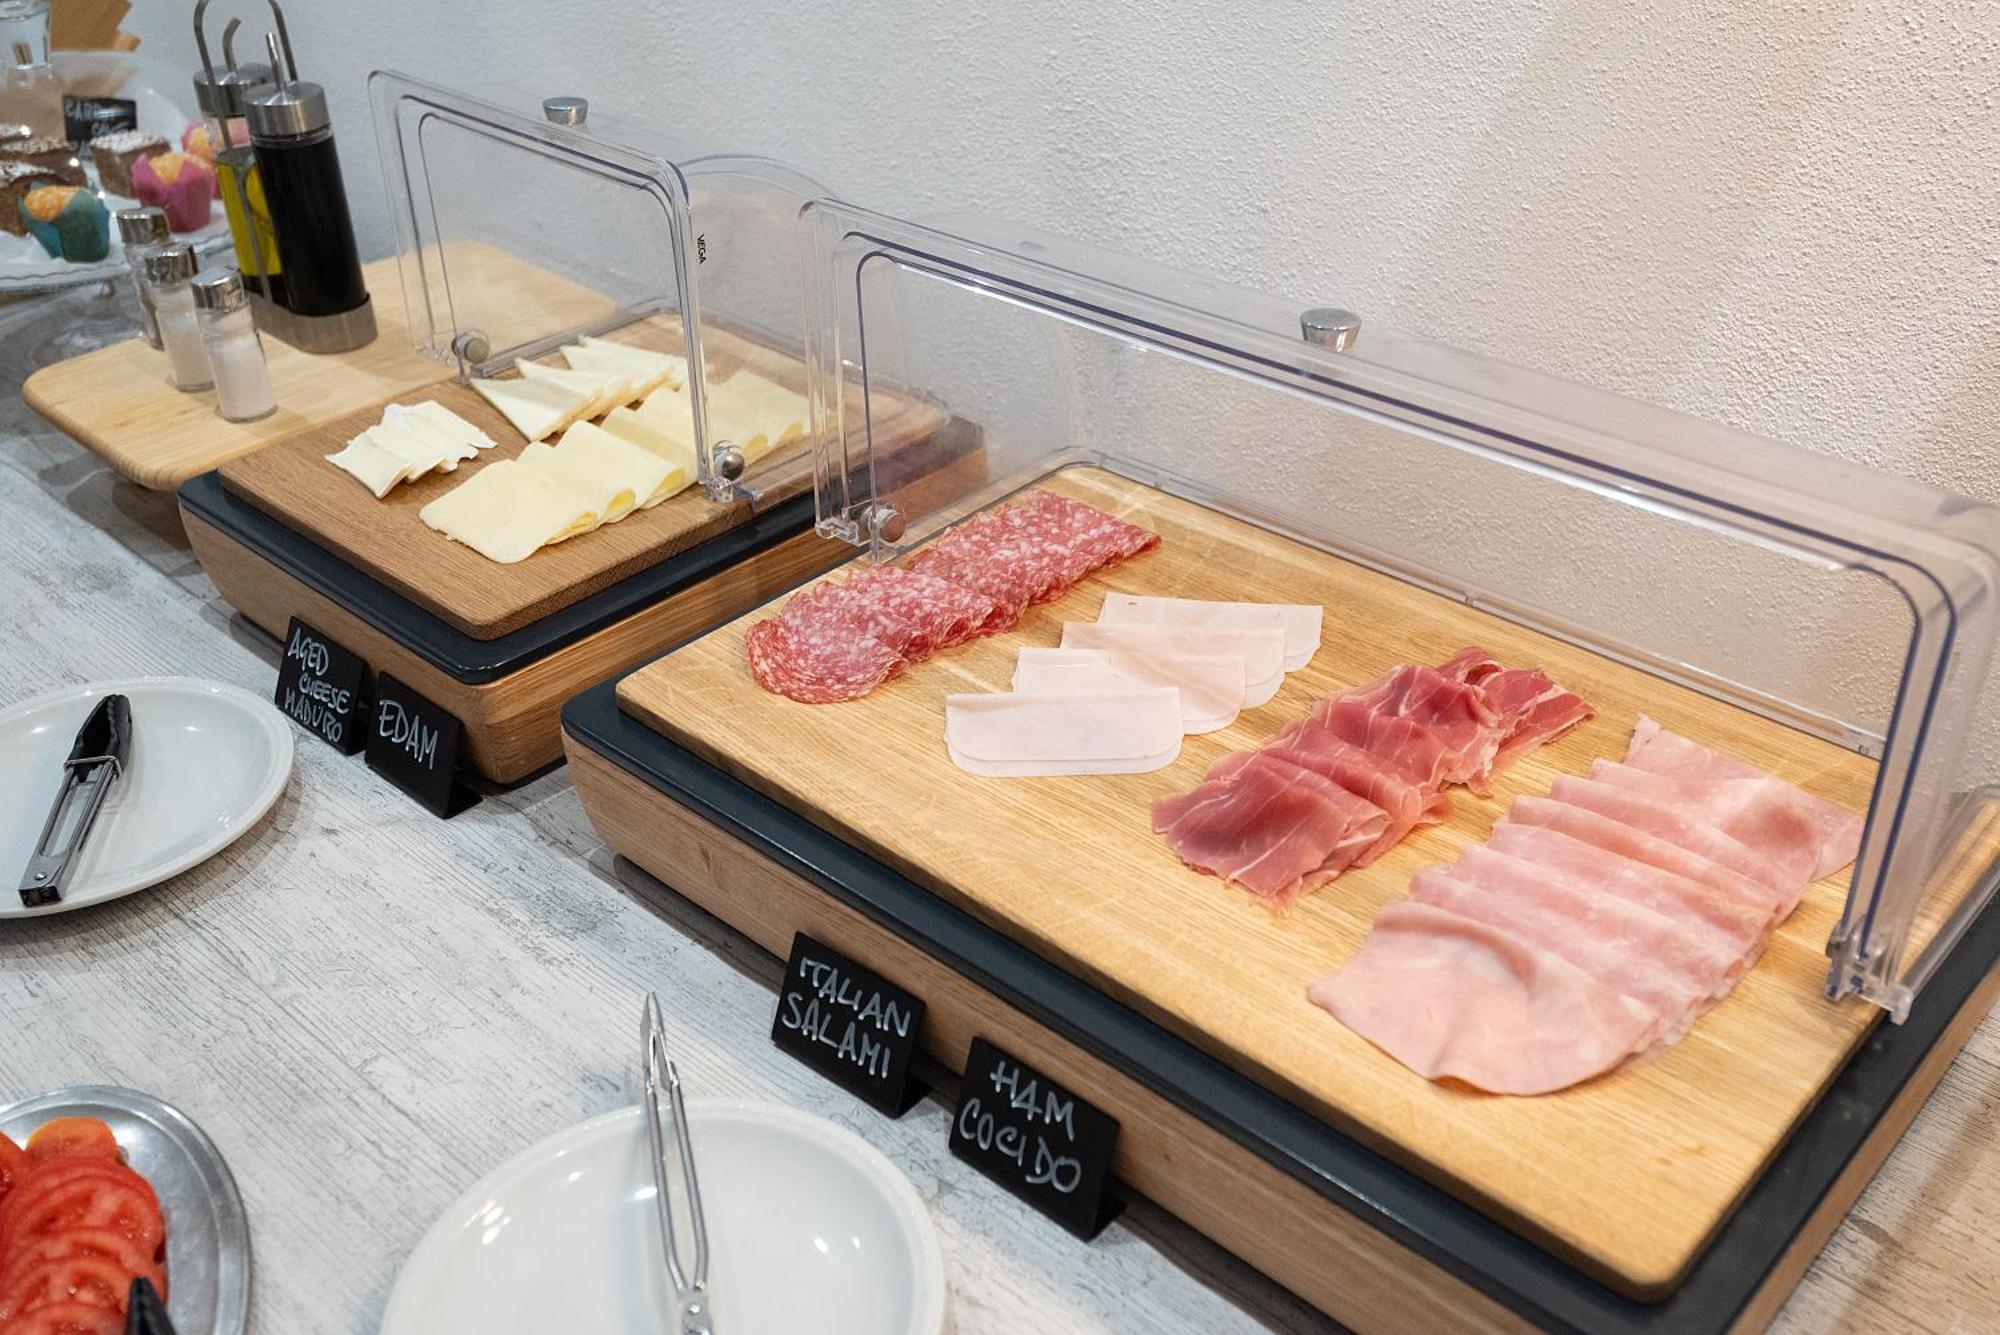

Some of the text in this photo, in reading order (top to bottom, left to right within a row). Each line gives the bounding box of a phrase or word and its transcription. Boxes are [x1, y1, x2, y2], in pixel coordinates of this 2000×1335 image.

[696, 232, 707, 265] VEGA
[287, 627, 329, 676] AGED
[284, 686, 344, 744] MADURO
[298, 672, 351, 715] CHEESE
[378, 698, 439, 771] EDAM
[799, 956, 911, 1037] ITALIAN
[781, 991, 891, 1079] SALAMI
[989, 1060, 1076, 1142] HAM
[959, 1097, 1082, 1193] COCIDO
